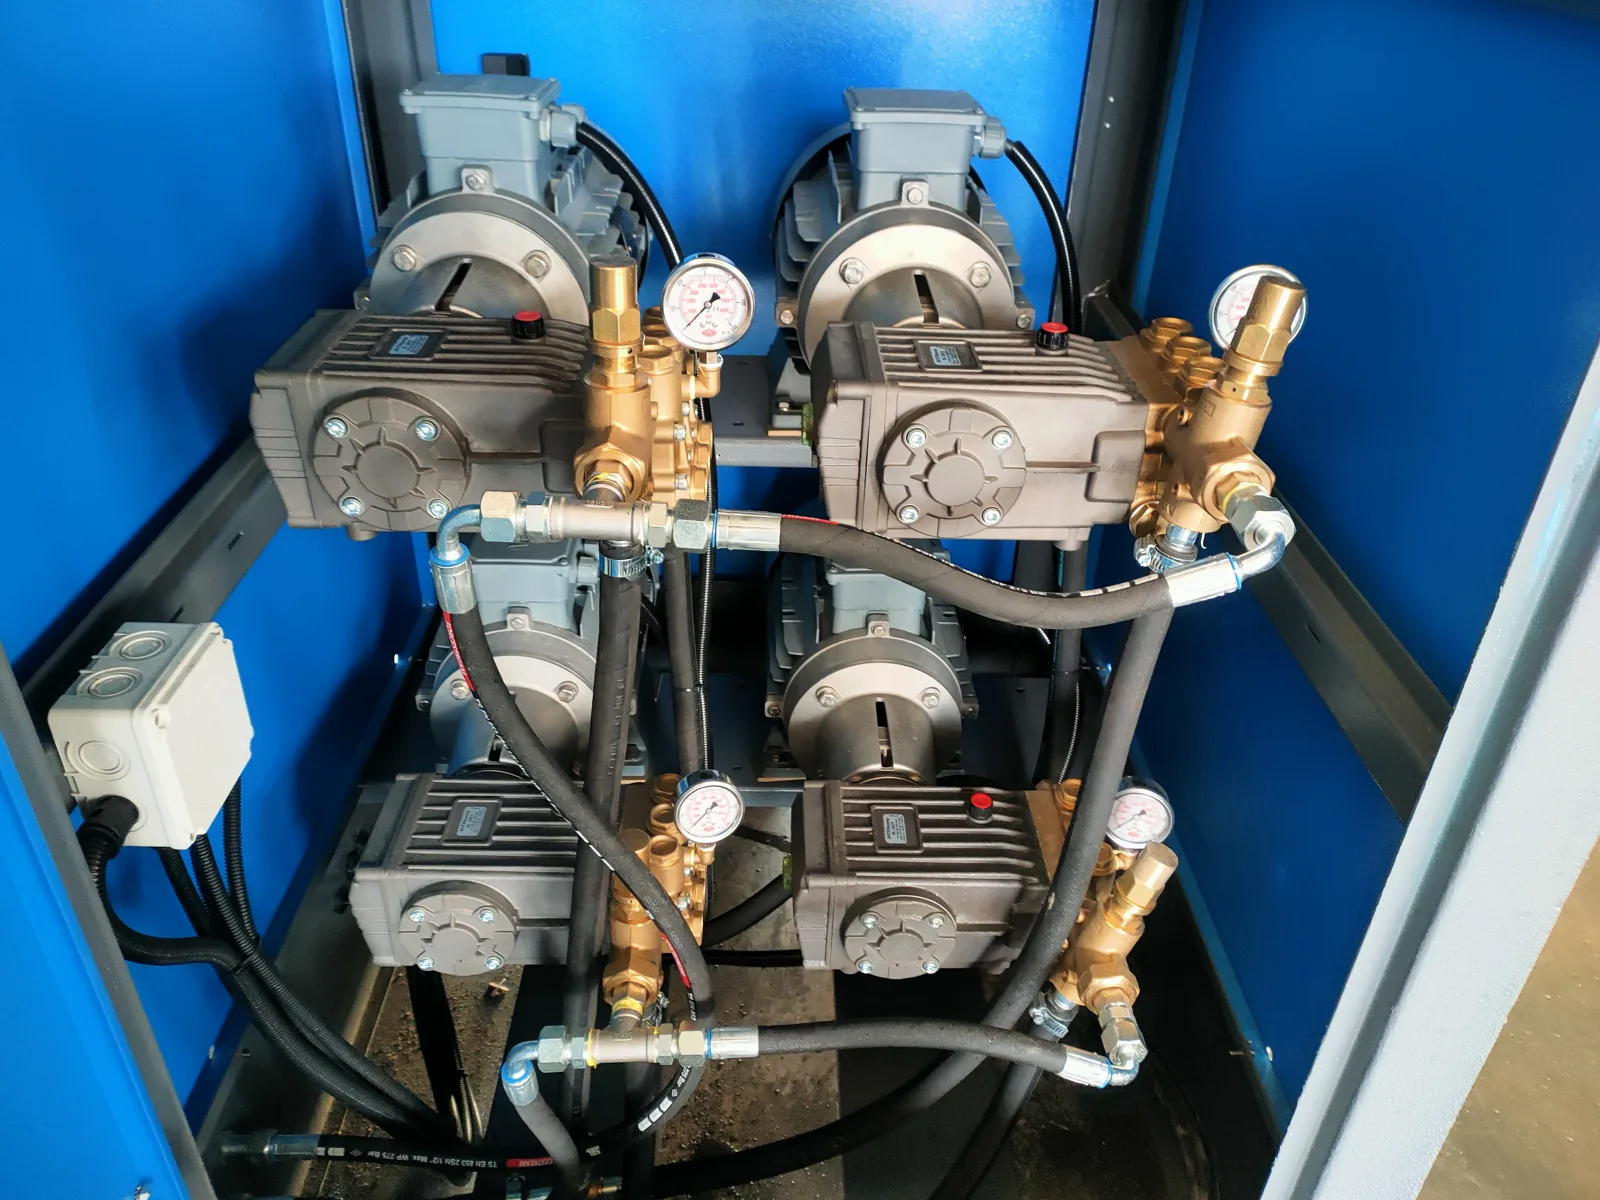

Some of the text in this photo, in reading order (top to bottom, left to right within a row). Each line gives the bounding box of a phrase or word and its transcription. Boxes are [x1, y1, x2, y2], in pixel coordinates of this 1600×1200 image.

[367, 1150, 381, 1158] Bar
[381, 1152, 395, 1160] 275
[444, 1158, 461, 1166] 2SN
[488, 1160, 498, 1168] TS
